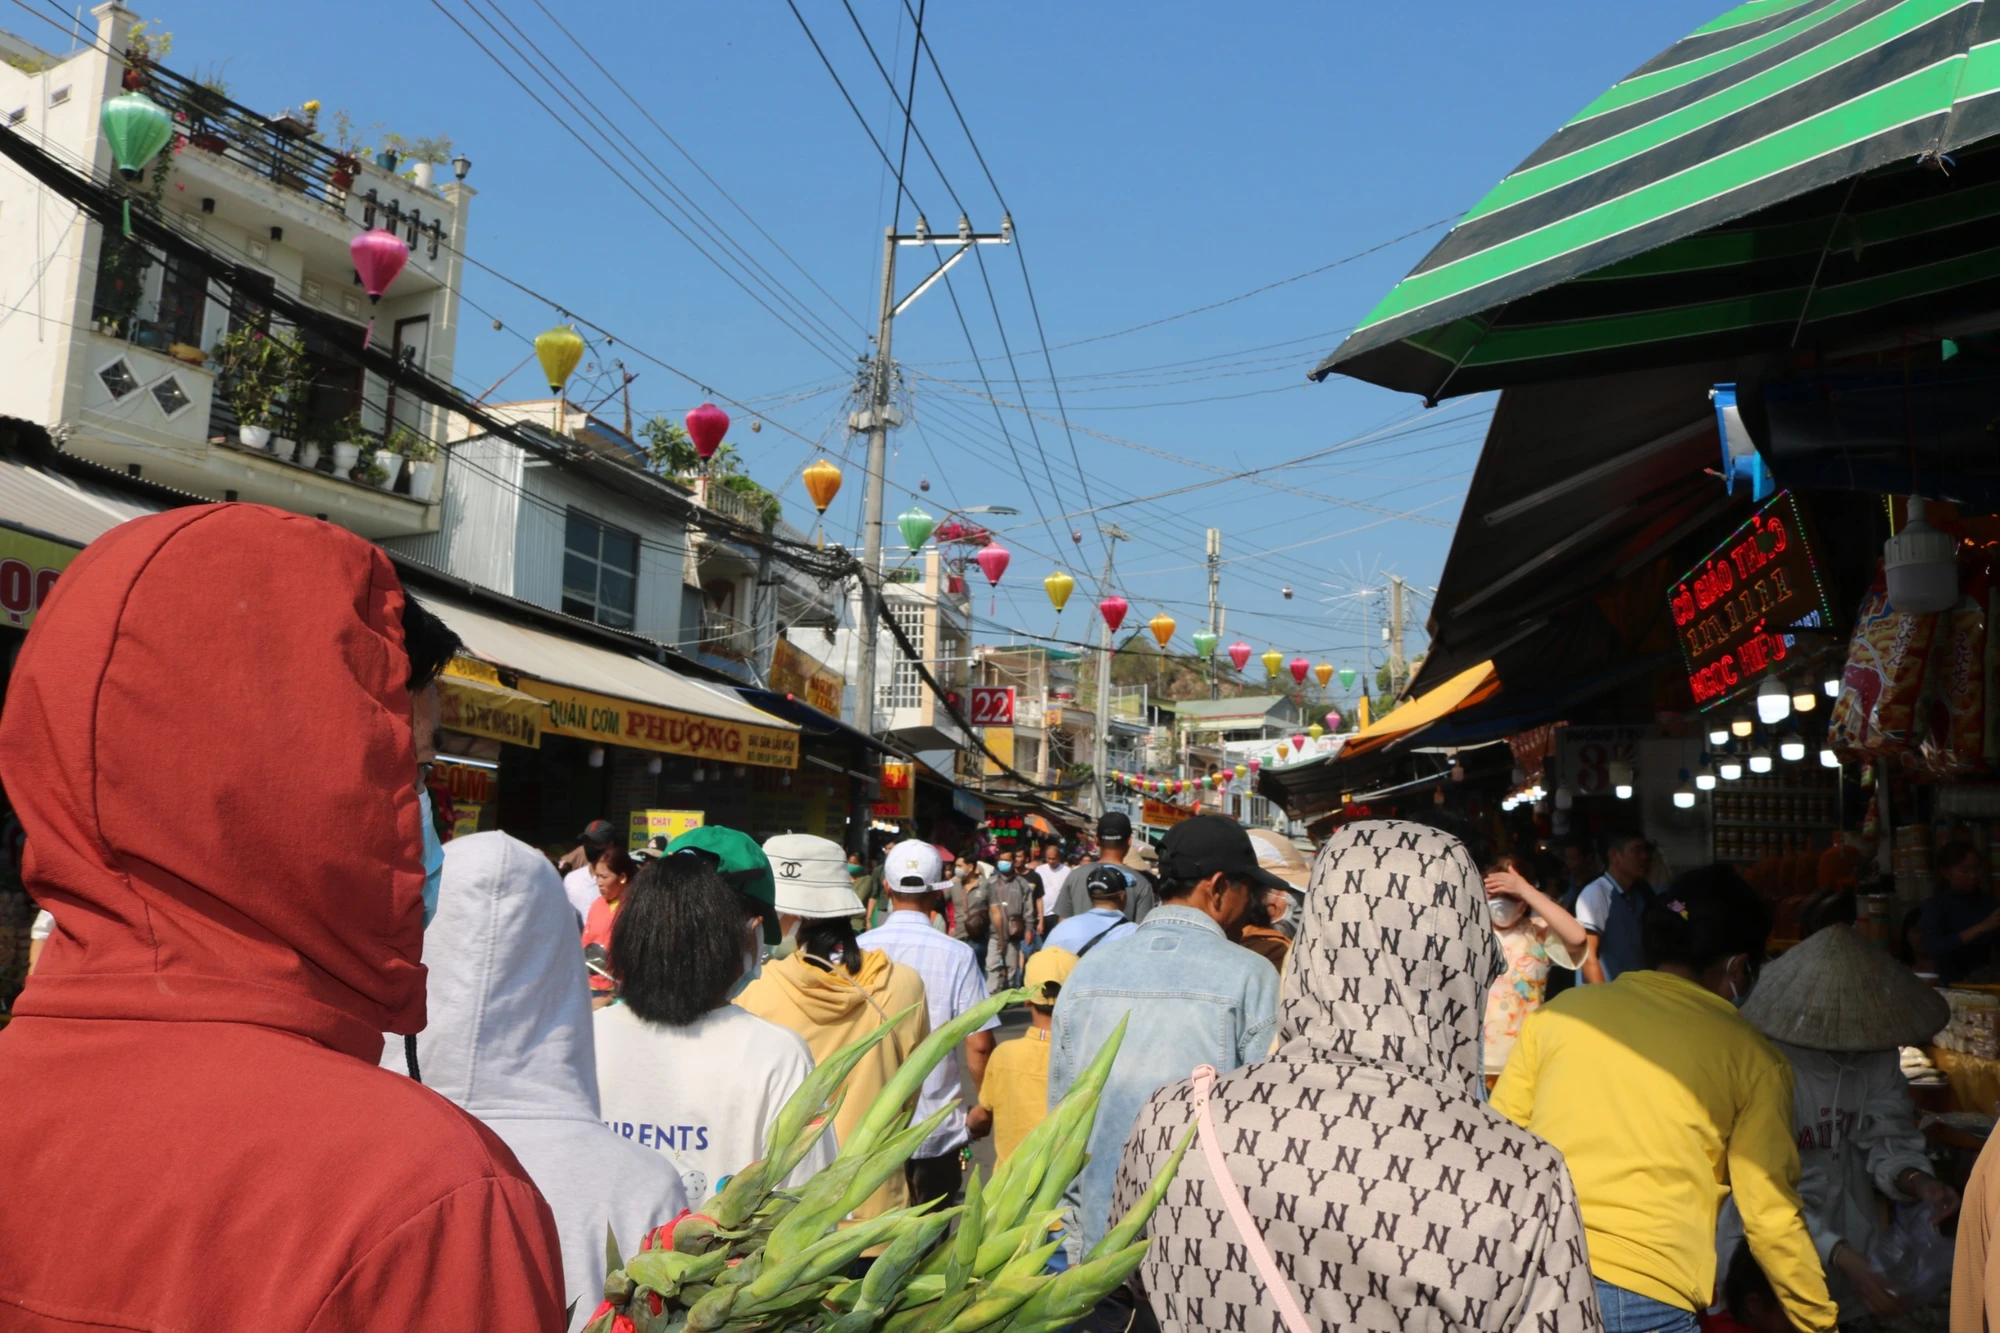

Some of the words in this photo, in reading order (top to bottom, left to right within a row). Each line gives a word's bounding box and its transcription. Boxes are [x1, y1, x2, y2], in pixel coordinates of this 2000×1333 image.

[1694, 560, 1733, 610] GIÁO
[1689, 654, 1738, 703] NGỌC
[550, 697, 588, 729] QUÁN
[591, 706, 620, 736] CƠM
[626, 710, 742, 753] PHƯỢNG
[974, 691, 1010, 722] 22
[1352, 830, 1377, 846] N
[1395, 832, 1421, 851] N
[1331, 848, 1347, 869] Y
[1373, 847, 1391, 868] Y
[1418, 853, 1436, 877] Y
[1458, 863, 1467, 888] Y
[1324, 895, 1338, 920] Y
[1364, 894, 1381, 919] Y
[1408, 902, 1427, 930] Y
[1457, 913, 1468, 940] Y
[1343, 869, 1365, 893] N
[1385, 873, 1410, 900] N
[1469, 895, 1481, 925] N
[1324, 949, 1338, 974] Y
[1363, 948, 1380, 975] Y
[1401, 958, 1418, 986] Y
[1438, 965, 1459, 991] Y
[1340, 922, 1360, 948] N
[1381, 927, 1402, 955] N
[1463, 948, 1477, 978] N
[1284, 999, 1299, 1020] Y
[1362, 1005, 1381, 1030] Y
[1339, 978, 1360, 1003] N
[1384, 978, 1403, 1006] N
[1442, 998, 1468, 1027] N
[1331, 1029, 1356, 1055] N
[1381, 1035, 1405, 1062] N
[1245, 1064, 1264, 1079] Y
[1289, 1064, 1307, 1083] Y
[1336, 1066, 1355, 1089] Y
[1386, 1073, 1406, 1098] Y
[1436, 1090, 1454, 1112] Y
[1209, 1080, 1233, 1100] N
[1248, 1082, 1277, 1104] N
[1296, 1087, 1325, 1111] N
[1346, 1093, 1375, 1120] N
[1398, 1105, 1428, 1131] N
[1450, 1119, 1477, 1144] N
[1500, 1137, 1525, 1160] N
[1225, 1100, 1243, 1122] Y
[1272, 1107, 1290, 1131] Y
[1321, 1114, 1340, 1139] Y
[1372, 1123, 1393, 1149] Y
[1425, 1134, 1445, 1159] Y
[1475, 1147, 1494, 1171] Y
[1523, 1164, 1540, 1188] Y
[1158, 1126, 1174, 1150] N
[1234, 1128, 1260, 1156] N
[1282, 1137, 1310, 1165] N
[1333, 1146, 1361, 1174] N
[1384, 1155, 1413, 1183] N
[1436, 1165, 1465, 1195] N
[1486, 1178, 1514, 1208] N
[1185, 1180, 1204, 1206] N
[1274, 1192, 1298, 1223] N
[1322, 1202, 1348, 1232] N
[1372, 1211, 1400, 1242] N
[1423, 1222, 1451, 1254] N
[1472, 1236, 1500, 1268] N
[1566, 1235, 1584, 1268] N
[1259, 1159, 1277, 1186] Y
[1308, 1168, 1327, 1195] Y
[1359, 1177, 1378, 1204] Y
[1411, 1187, 1430, 1215] Y
[1461, 1199, 1480, 1228] Y
[1510, 1212, 1527, 1243] Y
[1171, 1207, 1182, 1233] Y
[1205, 1209, 1224, 1237] Y
[1298, 1226, 1318, 1255] Y
[1347, 1235, 1367, 1265] Y
[1398, 1246, 1417, 1276] Y
[1448, 1258, 1467, 1289] Y
[1494, 1271, 1514, 1300] Y
[1554, 1271, 1570, 1303] Y
[1160, 1237, 1169, 1262] N
[1185, 1238, 1202, 1266] N
[1225, 1243, 1247, 1273] N
[1319, 1260, 1342, 1291] N
[1368, 1271, 1389, 1301] N
[1459, 1296, 1488, 1329] N
[1579, 1296, 1610, 1333] N
[1171, 1265, 1184, 1293] Y
[1205, 1268, 1222, 1297] Y
[1250, 1275, 1267, 1305] Y
[1299, 1283, 1315, 1314] Y
[1344, 1293, 1364, 1323] Y
[1392, 1305, 1411, 1333] Y
[1187, 1298, 1203, 1325] N
[1224, 1303, 1246, 1332] N
